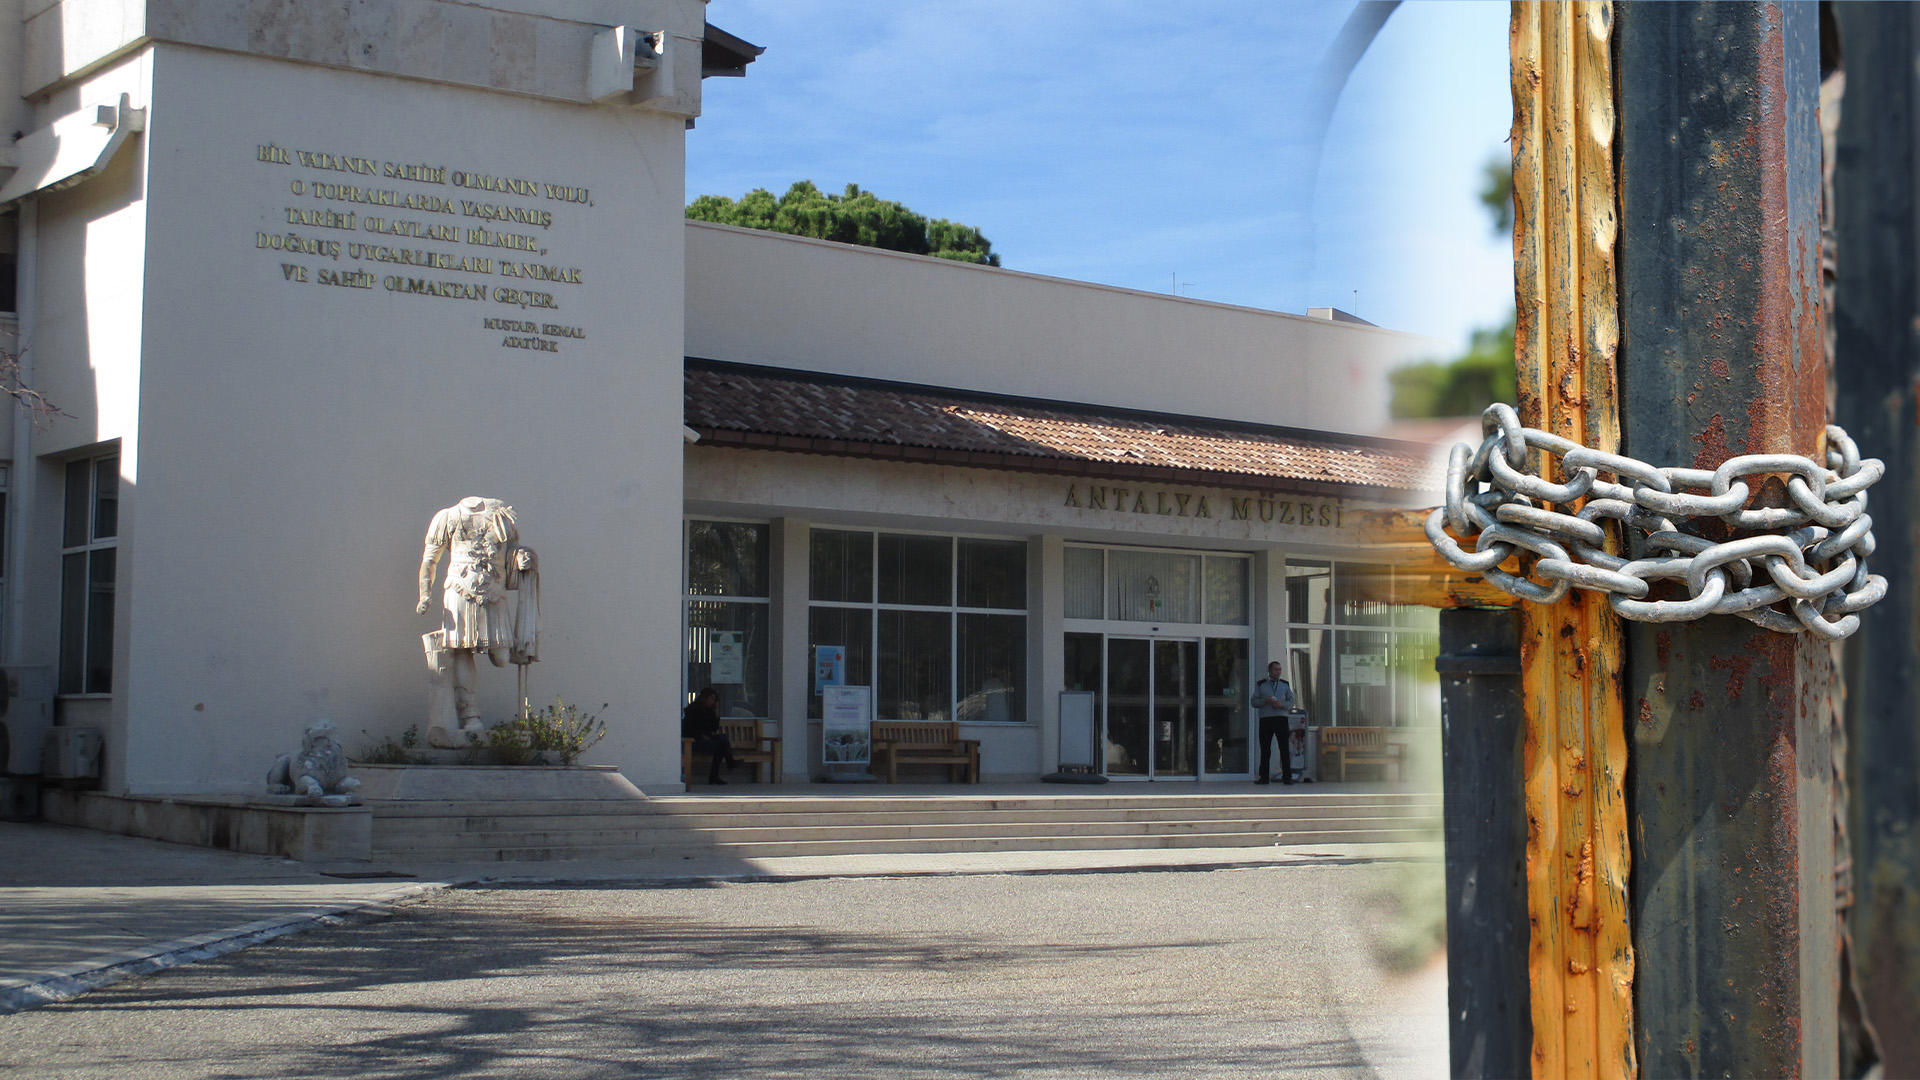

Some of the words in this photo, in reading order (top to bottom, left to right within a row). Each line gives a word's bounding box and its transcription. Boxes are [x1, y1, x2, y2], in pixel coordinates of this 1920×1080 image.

[257, 142, 291, 165] BİR
[296, 150, 377, 176] VATANIN
[384, 161, 446, 185] SAHİBİ
[452, 171, 538, 197] OLMANIN
[544, 183, 595, 207] YOLU,
[284, 207, 356, 230] TARİHİ
[364, 216, 460, 242] OLAYLARI
[291, 180, 306, 196] O
[312, 182, 455, 215] TOPRAKLARDA
[460, 200, 552, 230] YAŞANMIŞ
[256, 232, 341, 260] DOĞMUŞ
[349, 243, 493, 274] UYGARLIKLARI
[499, 259, 583, 284] TANIMAK
[281, 263, 308, 282] VE
[318, 267, 377, 289] SAHİP
[384, 275, 487, 300] OLMAKTAN
[494, 287, 559, 309] GEÇER.
[483, 318, 539, 334] MUSTAFA
[542, 323, 585, 339] KEMAL
[502, 335, 558, 352] ATATÜRK
[1064, 483, 1212, 519] ANTALYA
[1231, 491, 1346, 528] MÜZESİ
